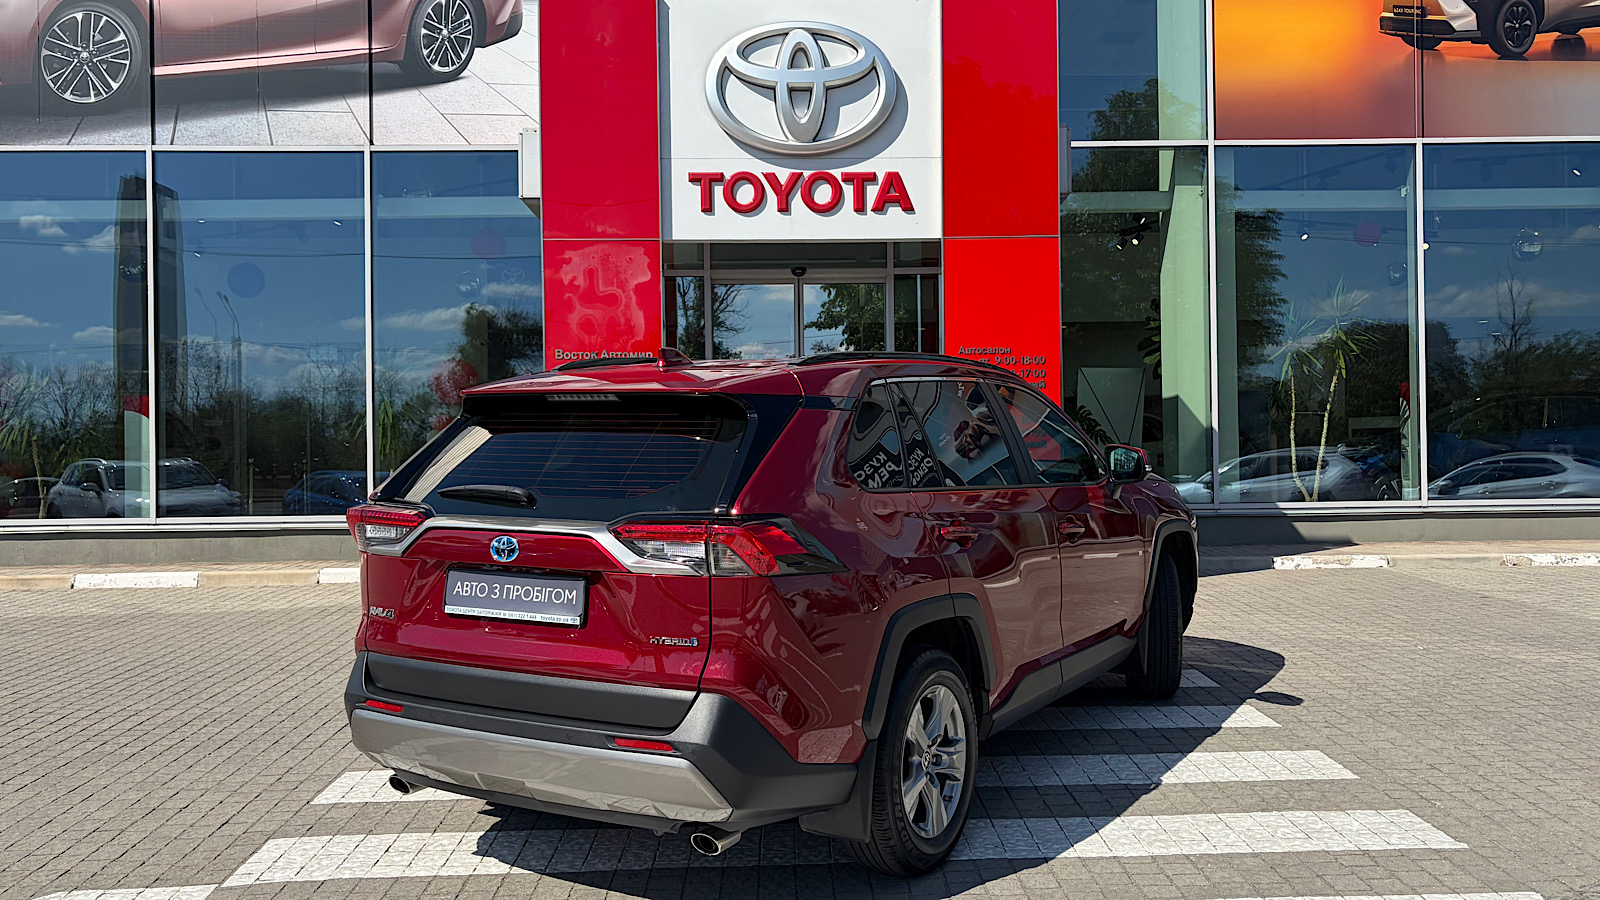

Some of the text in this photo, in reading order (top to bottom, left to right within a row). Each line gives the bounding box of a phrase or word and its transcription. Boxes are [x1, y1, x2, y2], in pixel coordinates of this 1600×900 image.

[688, 170, 915, 214] TOYOTA
[555, 349, 599, 360] Восток
[958, 346, 1012, 355] Автосалон
[453, 581, 488, 598] АВТО
[503, 584, 577, 605] ПРОБІГОМ
[369, 605, 395, 619] RAV4
[650, 636, 691, 646] HYBRID
